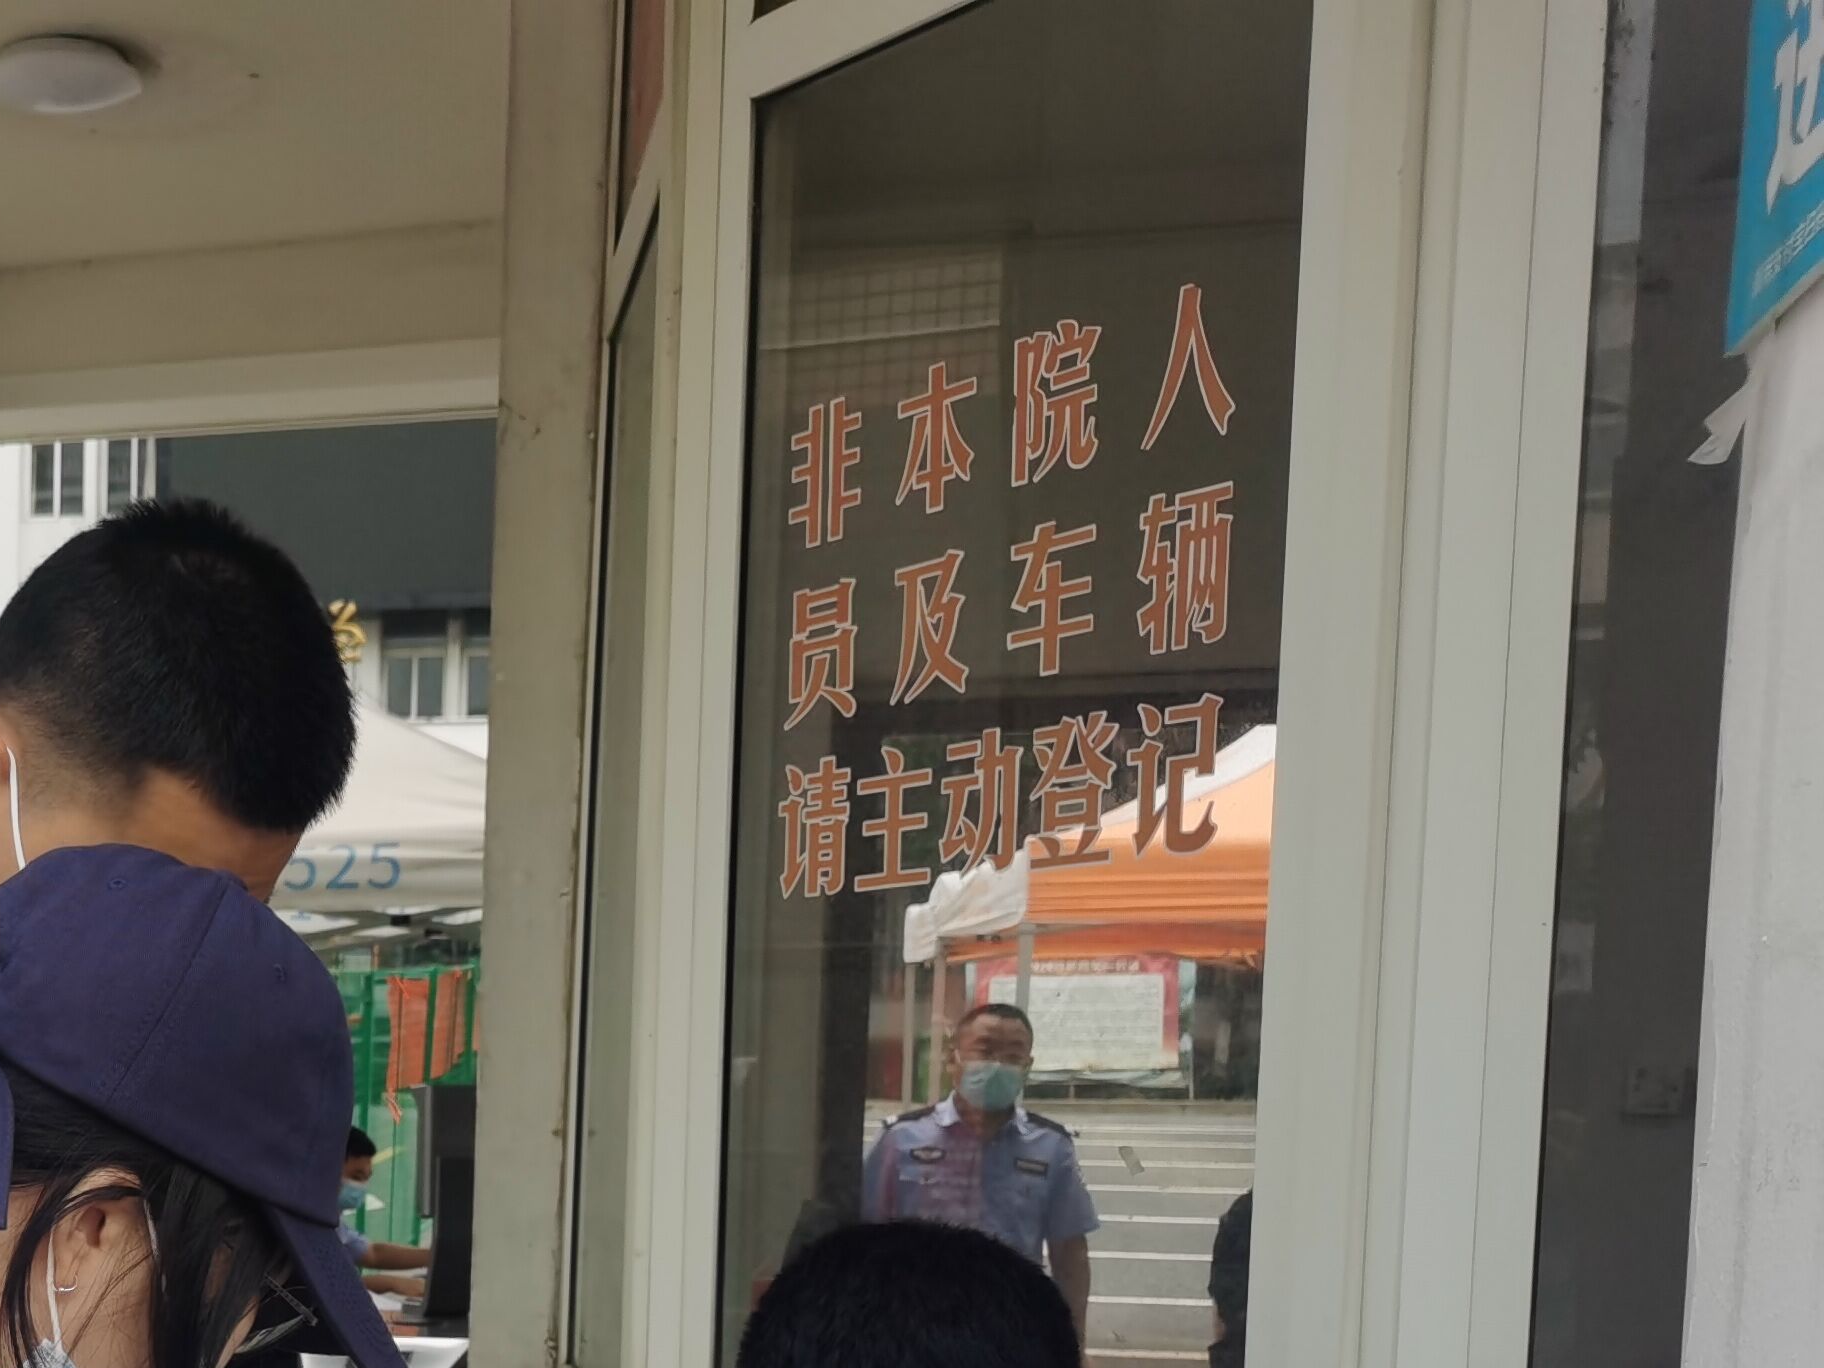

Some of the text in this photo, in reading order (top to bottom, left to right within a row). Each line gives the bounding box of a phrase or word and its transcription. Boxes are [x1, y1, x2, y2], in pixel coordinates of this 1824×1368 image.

[788, 282, 1235, 549] 非本院人
[783, 481, 1234, 731] 员及车辆
[778, 692, 1223, 899] 请主动登记
